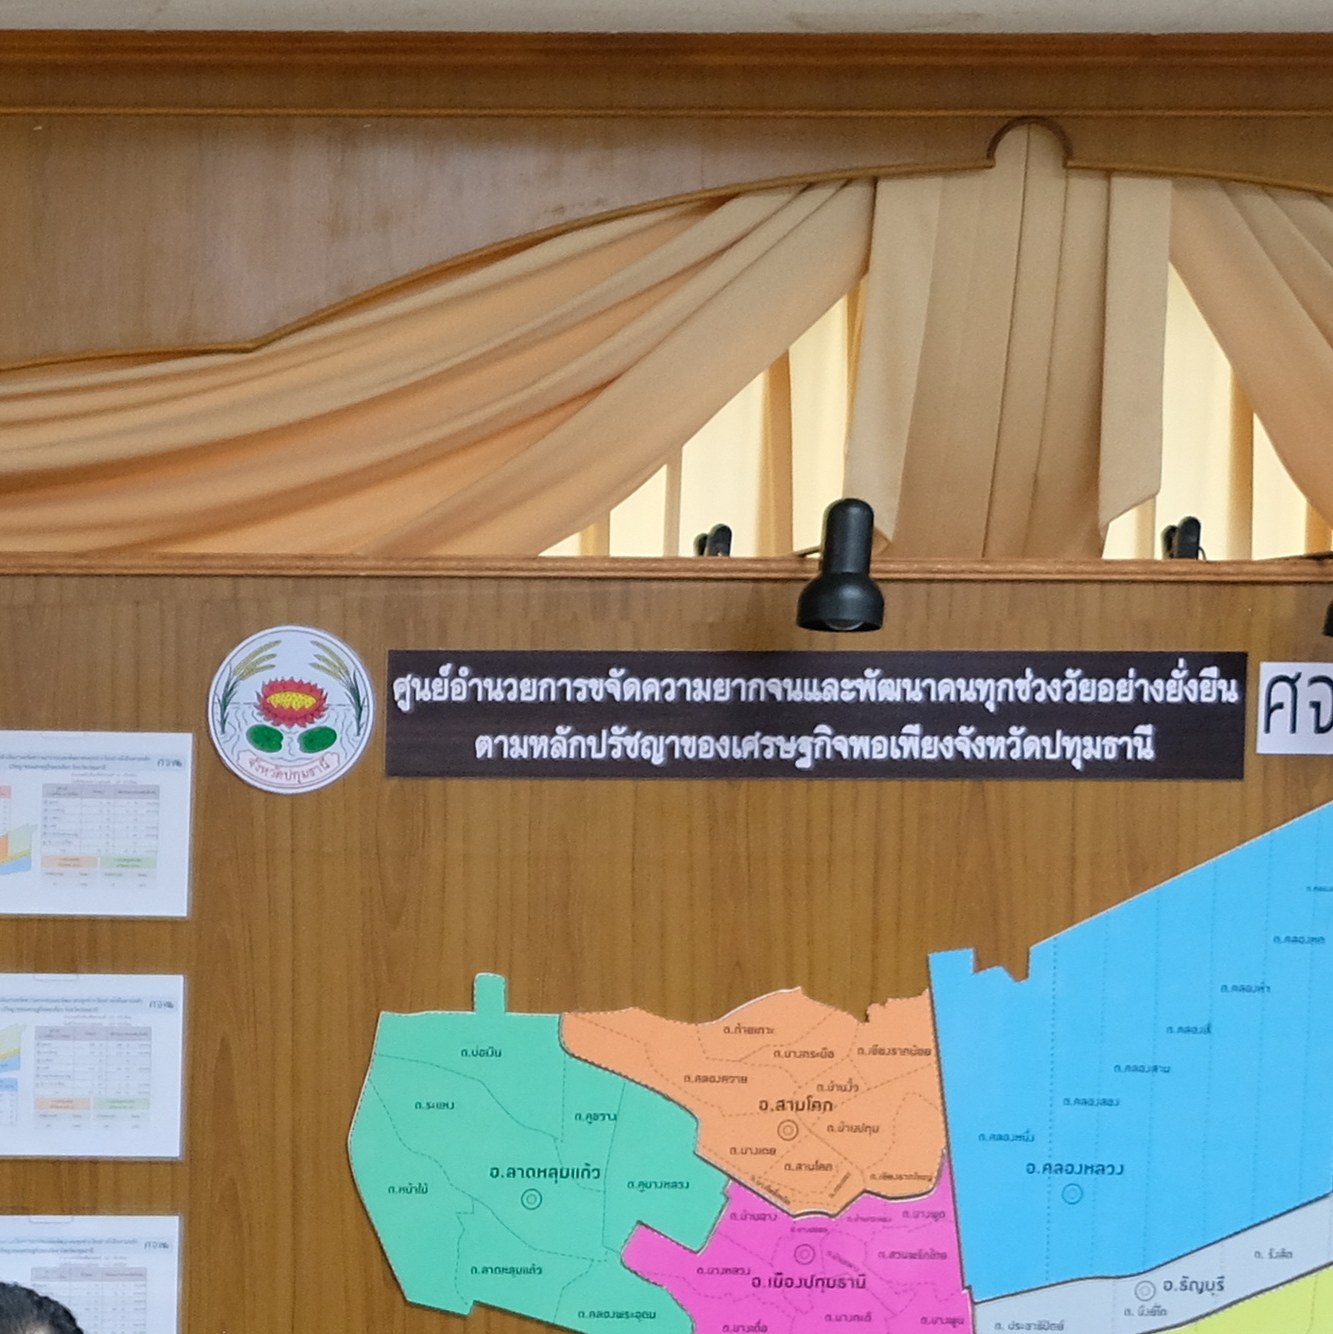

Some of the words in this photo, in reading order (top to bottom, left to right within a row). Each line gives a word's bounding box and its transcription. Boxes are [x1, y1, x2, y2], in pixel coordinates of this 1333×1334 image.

[392, 658, 1239, 712] ศูนย์อำนวยการขจัดความยากจนและพัฒนาคนทุกช่วงวัยอย่างยั่งยืน
[474, 723, 1155, 770] ตามหลักปรัชญาของเศรษฐกิจพอเพียงจังหวัดปทุมธานี
[489, 1164, 601, 1184] อ.ลาดหลุมแก้ว
[1025, 1161, 1125, 1177] อ.คลองหลวง
